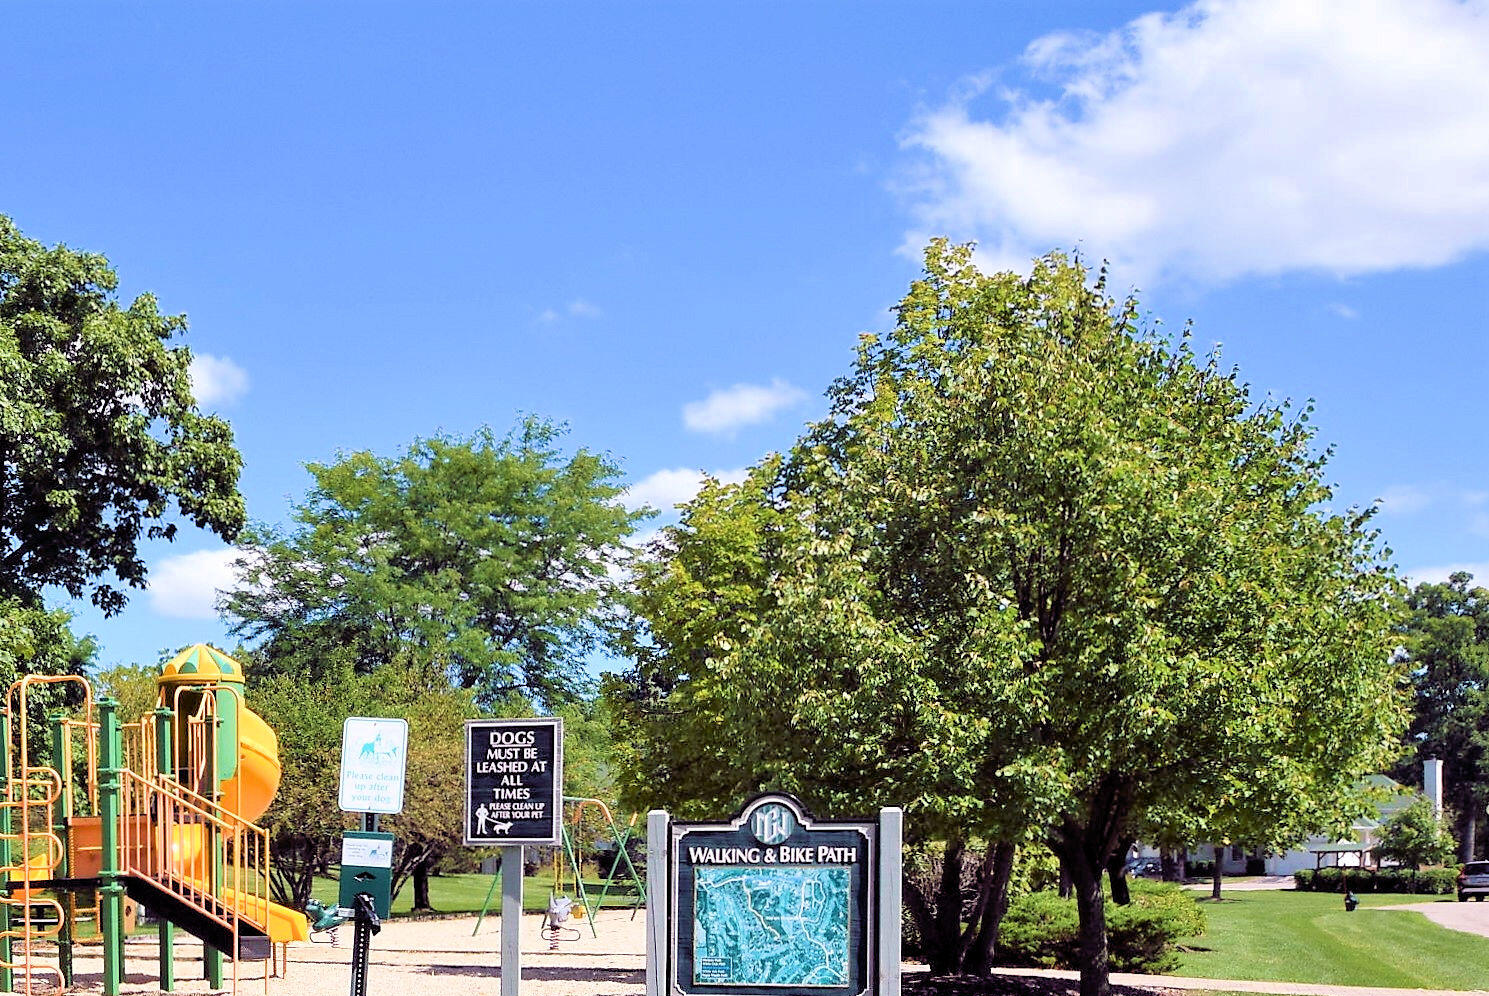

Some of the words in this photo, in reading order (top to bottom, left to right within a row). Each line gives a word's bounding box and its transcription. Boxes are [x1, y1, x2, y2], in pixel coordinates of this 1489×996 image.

[489, 731, 535, 745] DOGS
[487, 748, 520, 760] MUST
[523, 747, 538, 759] BE
[476, 761, 528, 774] LEASHED
[531, 761, 547, 773] AT
[346, 770, 373, 781] Please
[376, 772, 399, 782] clean
[500, 774, 523, 786] ALL
[368, 782, 388, 792] after
[493, 788, 531, 800] TIMES
[490, 811, 511, 819] AFTER
[511, 811, 530, 819] YOUR
[531, 811, 543, 819] PET
[689, 847, 760, 864] WALKING
[764, 849, 776, 863] &
[779, 846, 814, 863] BIKE
[817, 846, 857, 863] PATH
